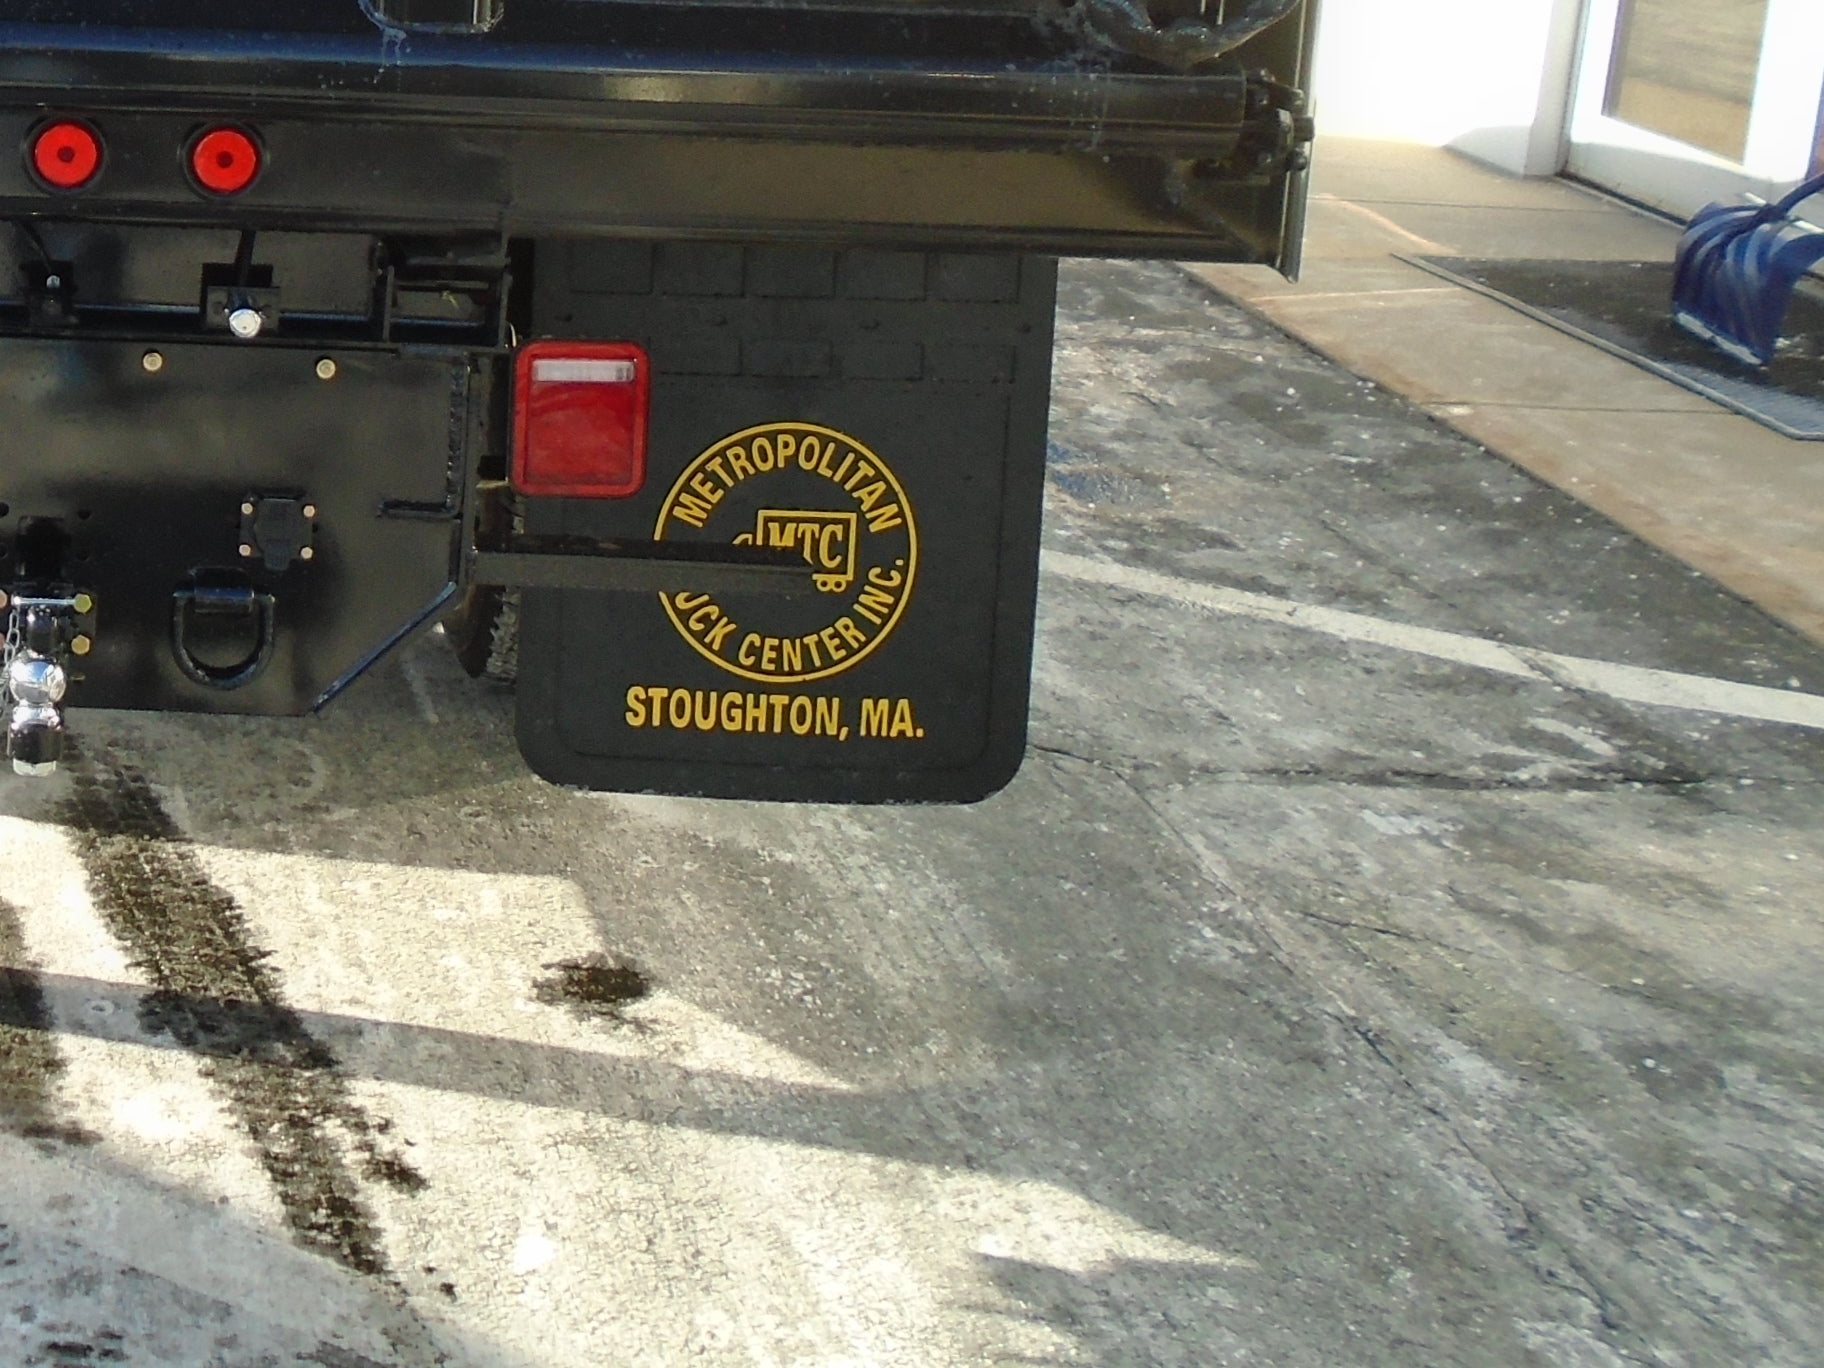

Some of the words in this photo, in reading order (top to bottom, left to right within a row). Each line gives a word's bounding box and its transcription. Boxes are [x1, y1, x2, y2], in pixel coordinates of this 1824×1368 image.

[672, 433, 902, 534] METROPOLITAN
[674, 591, 737, 651] UCK
[738, 615, 868, 673] CENTER
[853, 558, 905, 625] INC.
[625, 684, 850, 742] STOUGHTON,
[859, 697, 926, 739] MA.
